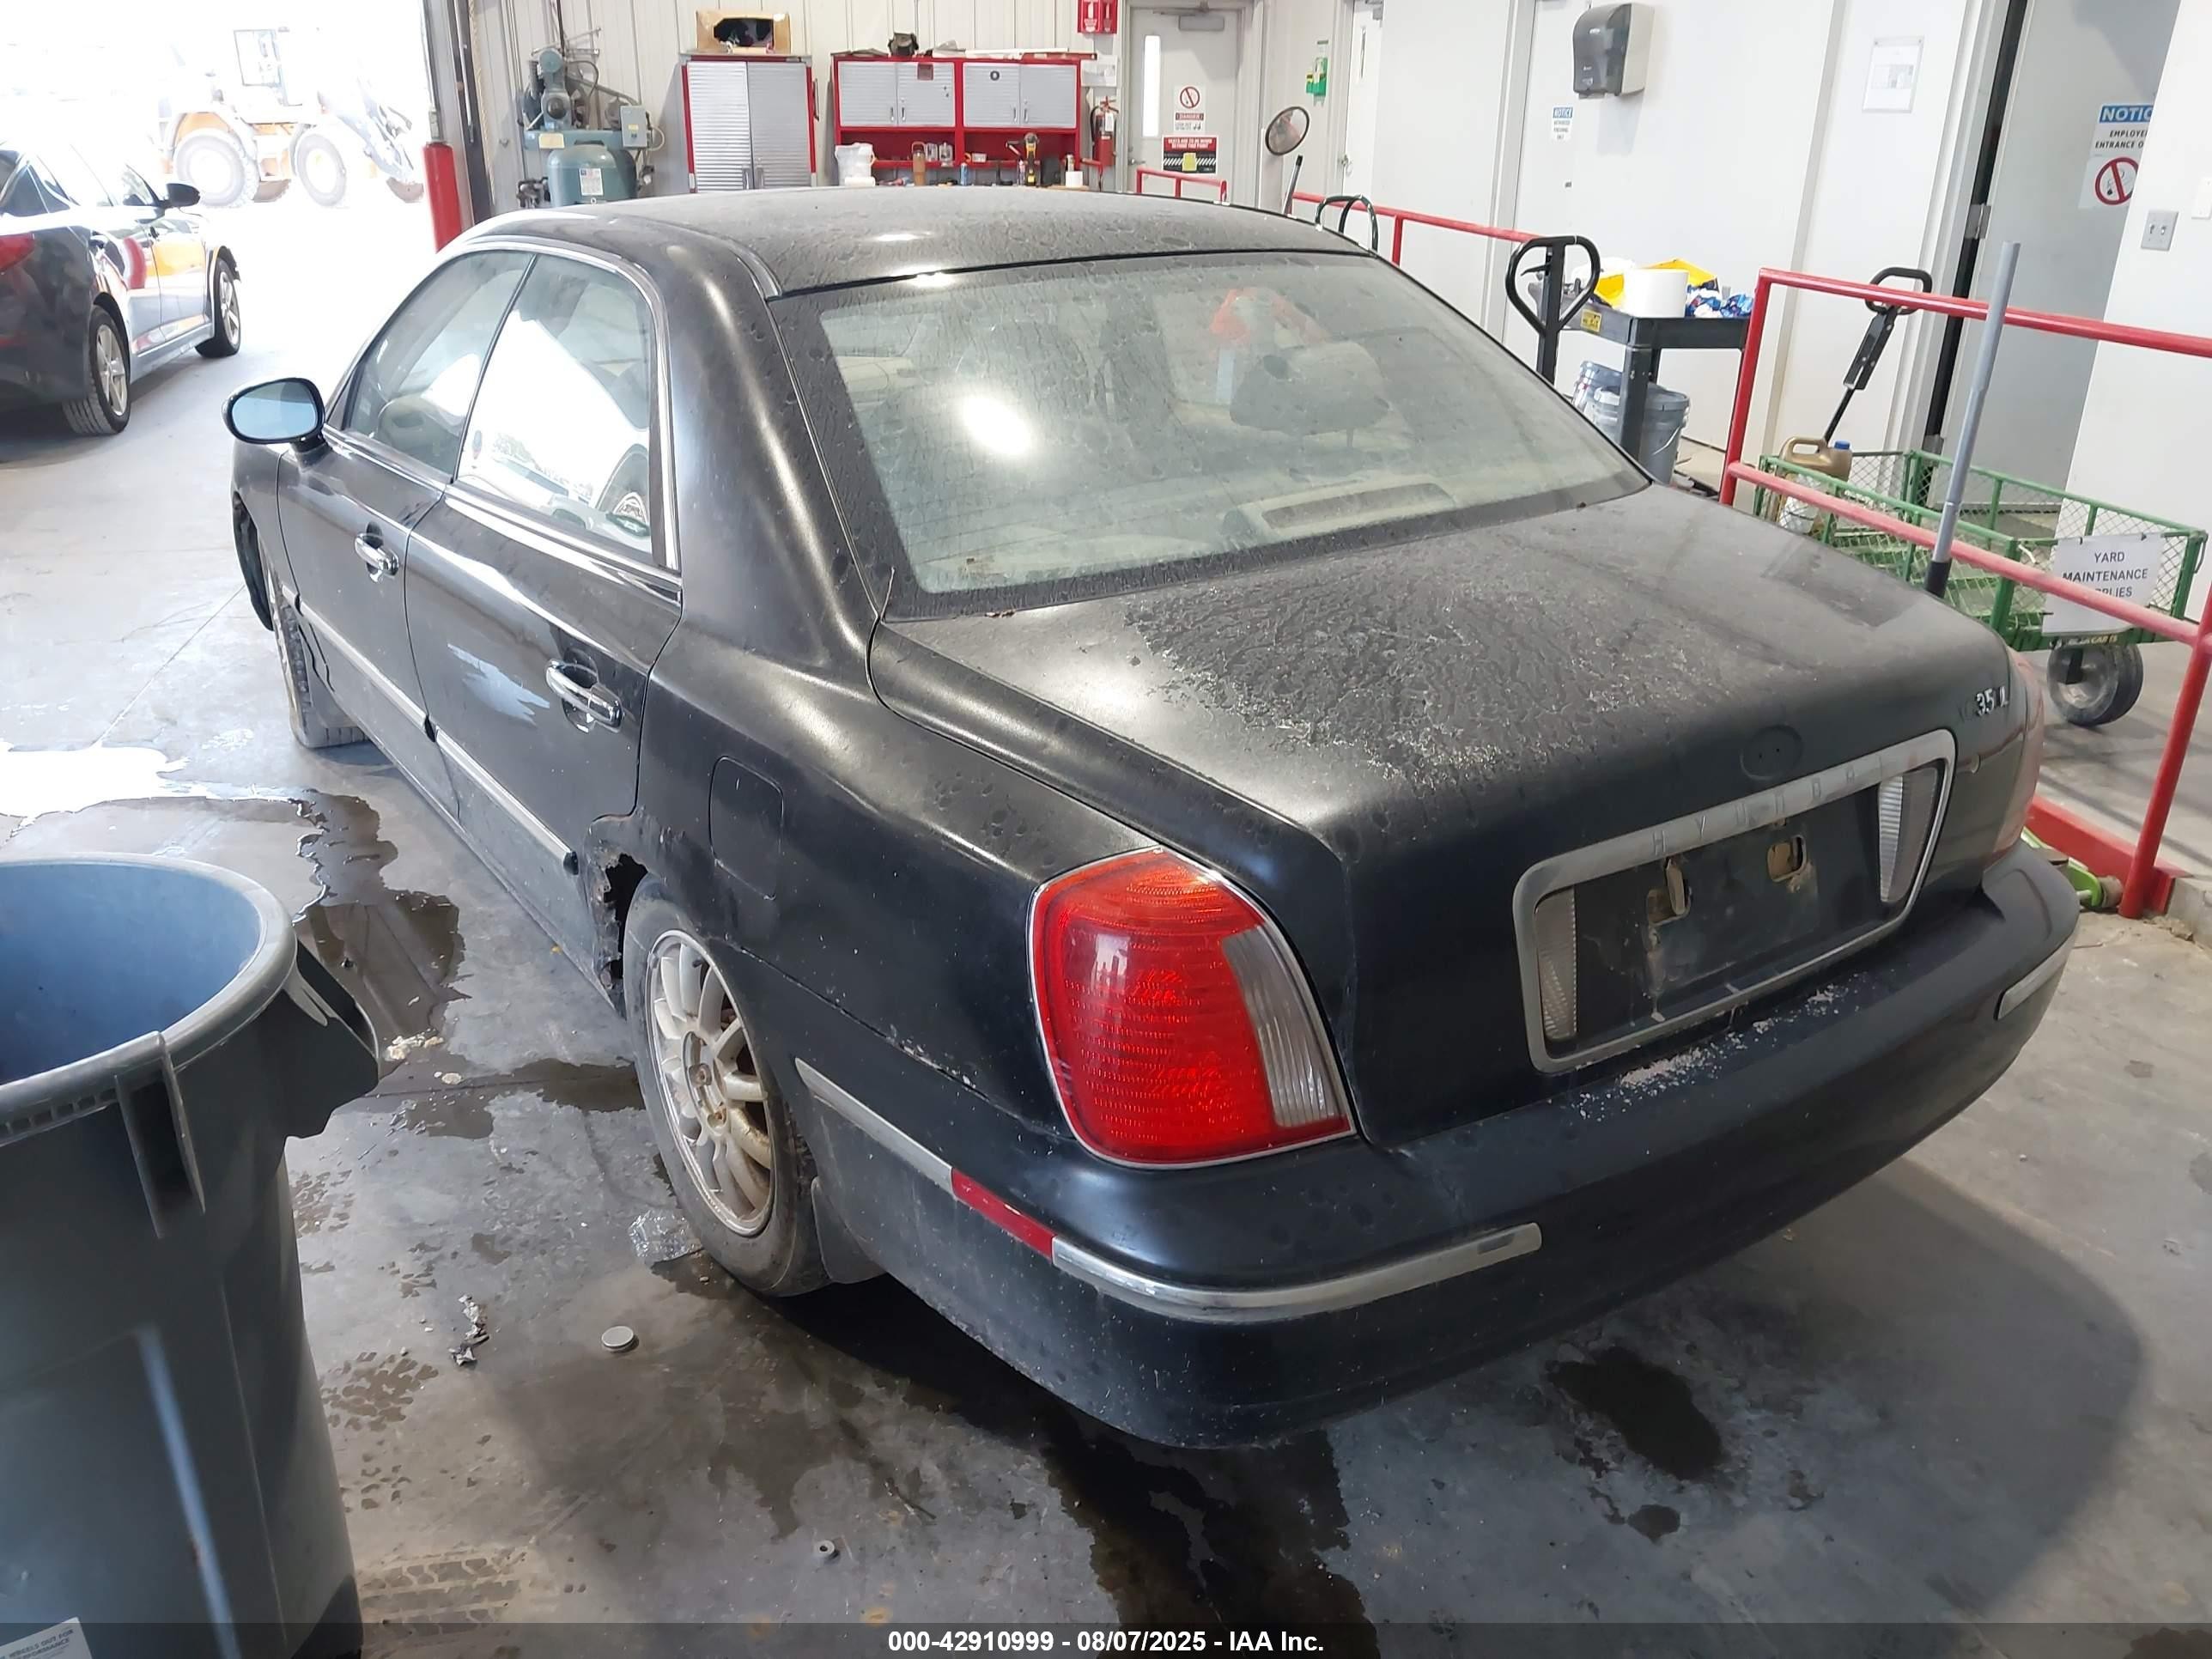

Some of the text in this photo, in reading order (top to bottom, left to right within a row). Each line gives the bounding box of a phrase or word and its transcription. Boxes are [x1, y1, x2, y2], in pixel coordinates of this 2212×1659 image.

[2101, 107, 2153, 121] NOTIC
[2094, 551, 2125, 563] YARD
[2062, 568, 2148, 582] MAINTENANCE
